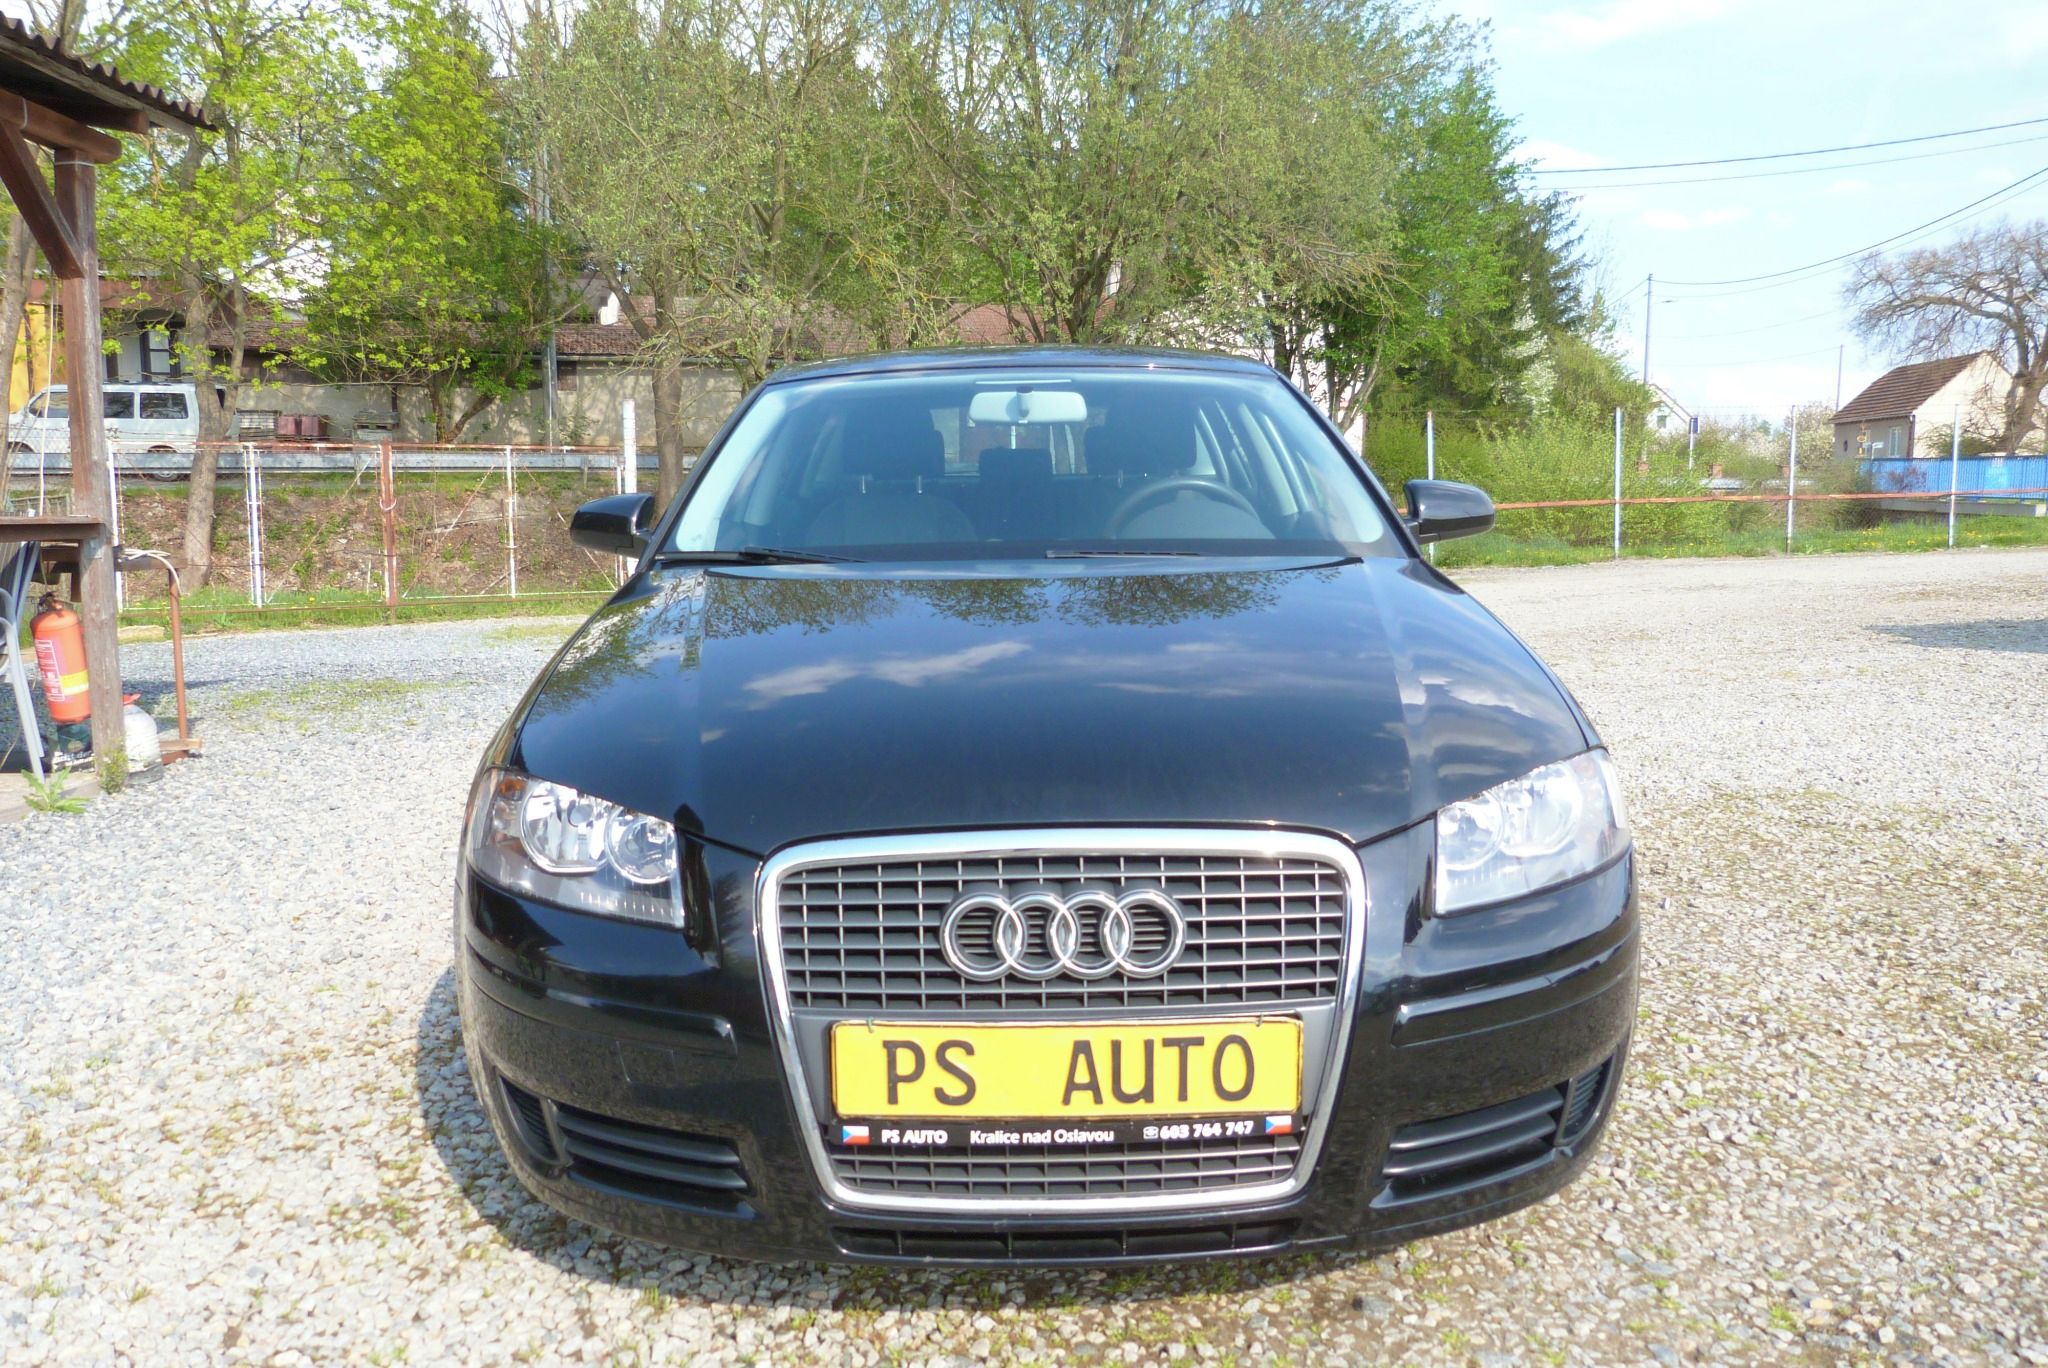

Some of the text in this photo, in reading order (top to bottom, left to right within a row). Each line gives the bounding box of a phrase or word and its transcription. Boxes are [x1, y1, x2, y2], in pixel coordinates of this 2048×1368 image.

[882, 1034, 1255, 1106] PS AUTO
[881, 1129, 900, 1144] PS
[903, 1129, 948, 1144] AUTO
[970, 1130, 1020, 1144] Kralice
[1023, 1129, 1051, 1143] nad
[1054, 1128, 1115, 1143] Oslavou
[1192, 1122, 1222, 1138] 764
[1225, 1120, 1254, 1136] 747
